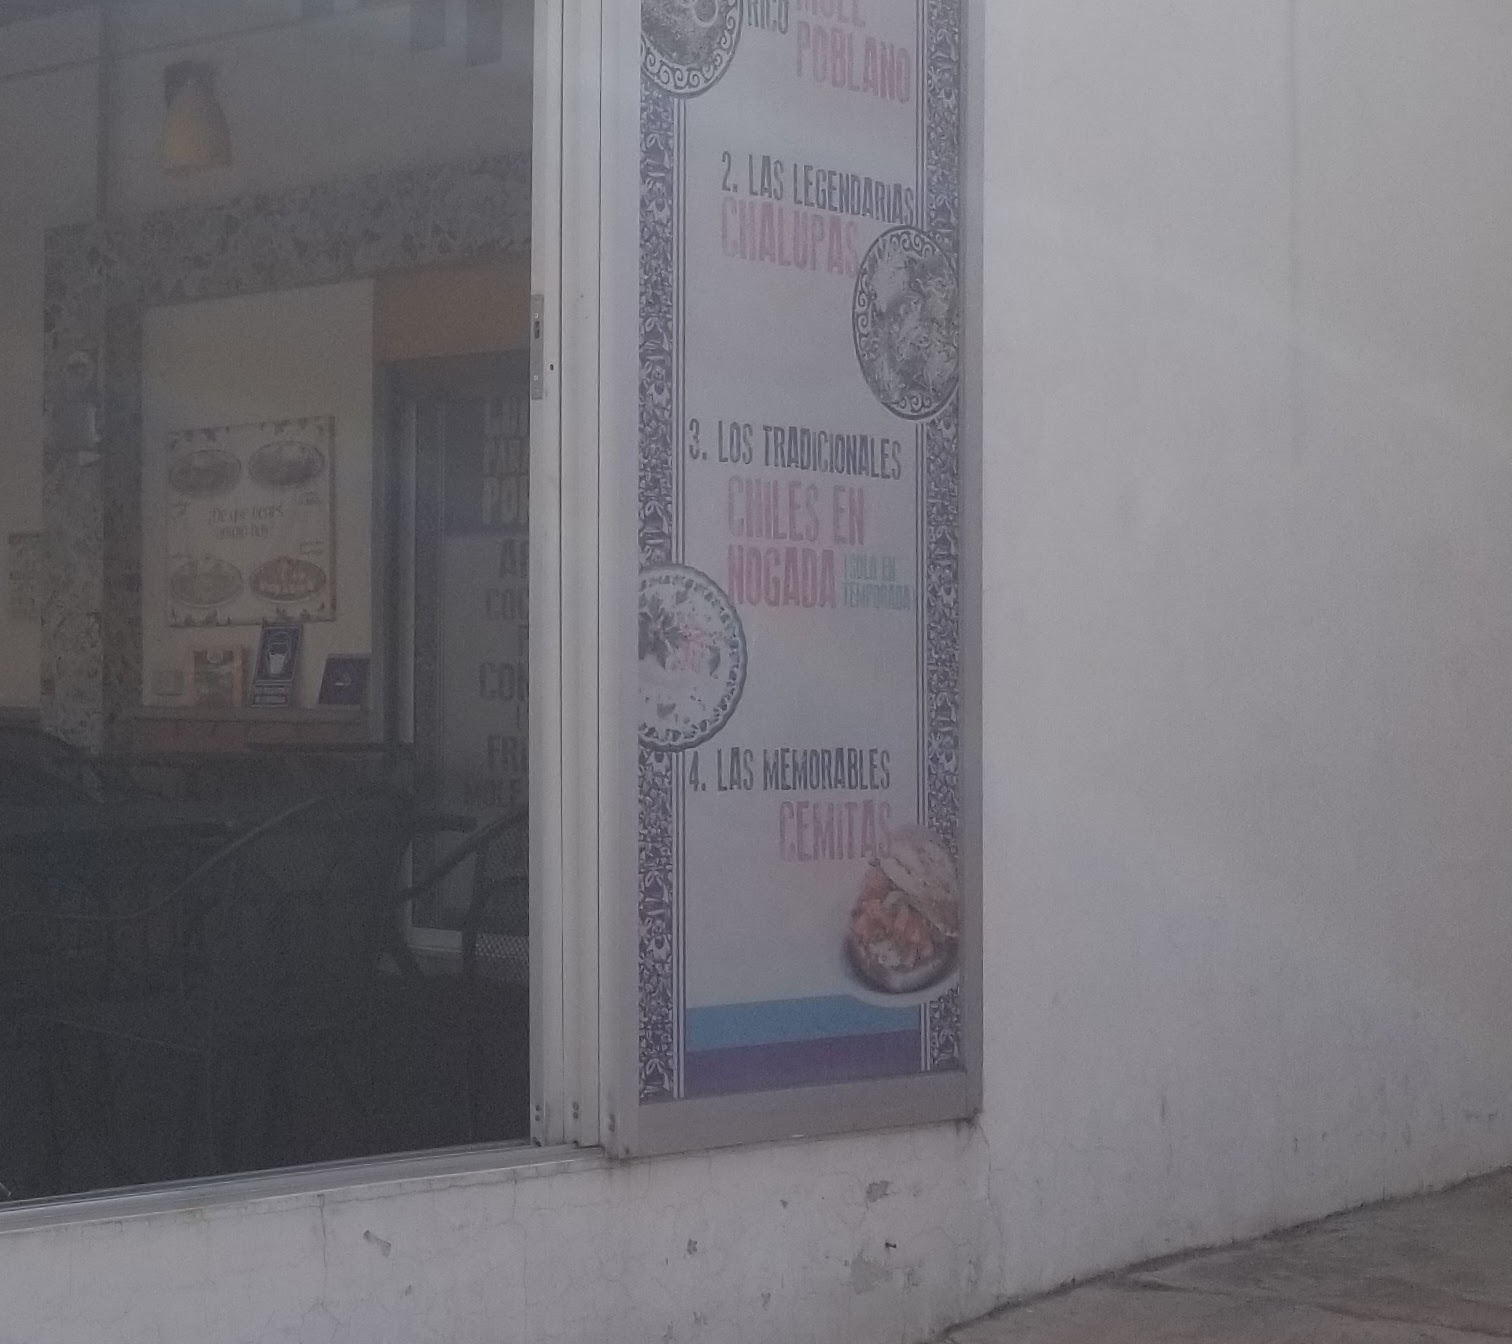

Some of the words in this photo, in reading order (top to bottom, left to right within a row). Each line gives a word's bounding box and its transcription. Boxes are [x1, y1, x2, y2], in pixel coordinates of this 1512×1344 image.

[795, 19, 912, 106] POBLANO
[721, 150, 738, 194] 2.
[748, 153, 785, 201] LAS
[792, 163, 915, 225] LEGENDARIAS
[720, 196, 859, 280] CHALUPAS
[688, 418, 708, 461] 3.
[718, 420, 754, 465] LOS
[762, 424, 901, 481] TRADICIONALES
[727, 474, 820, 542] CHILES
[832, 485, 865, 546] EN
[727, 544, 837, 609] NOGADA
[689, 750, 707, 792] 4.
[716, 746, 755, 792] LAS
[761, 746, 891, 792] MEMORABLES
[778, 799, 892, 862] CEMITAS
